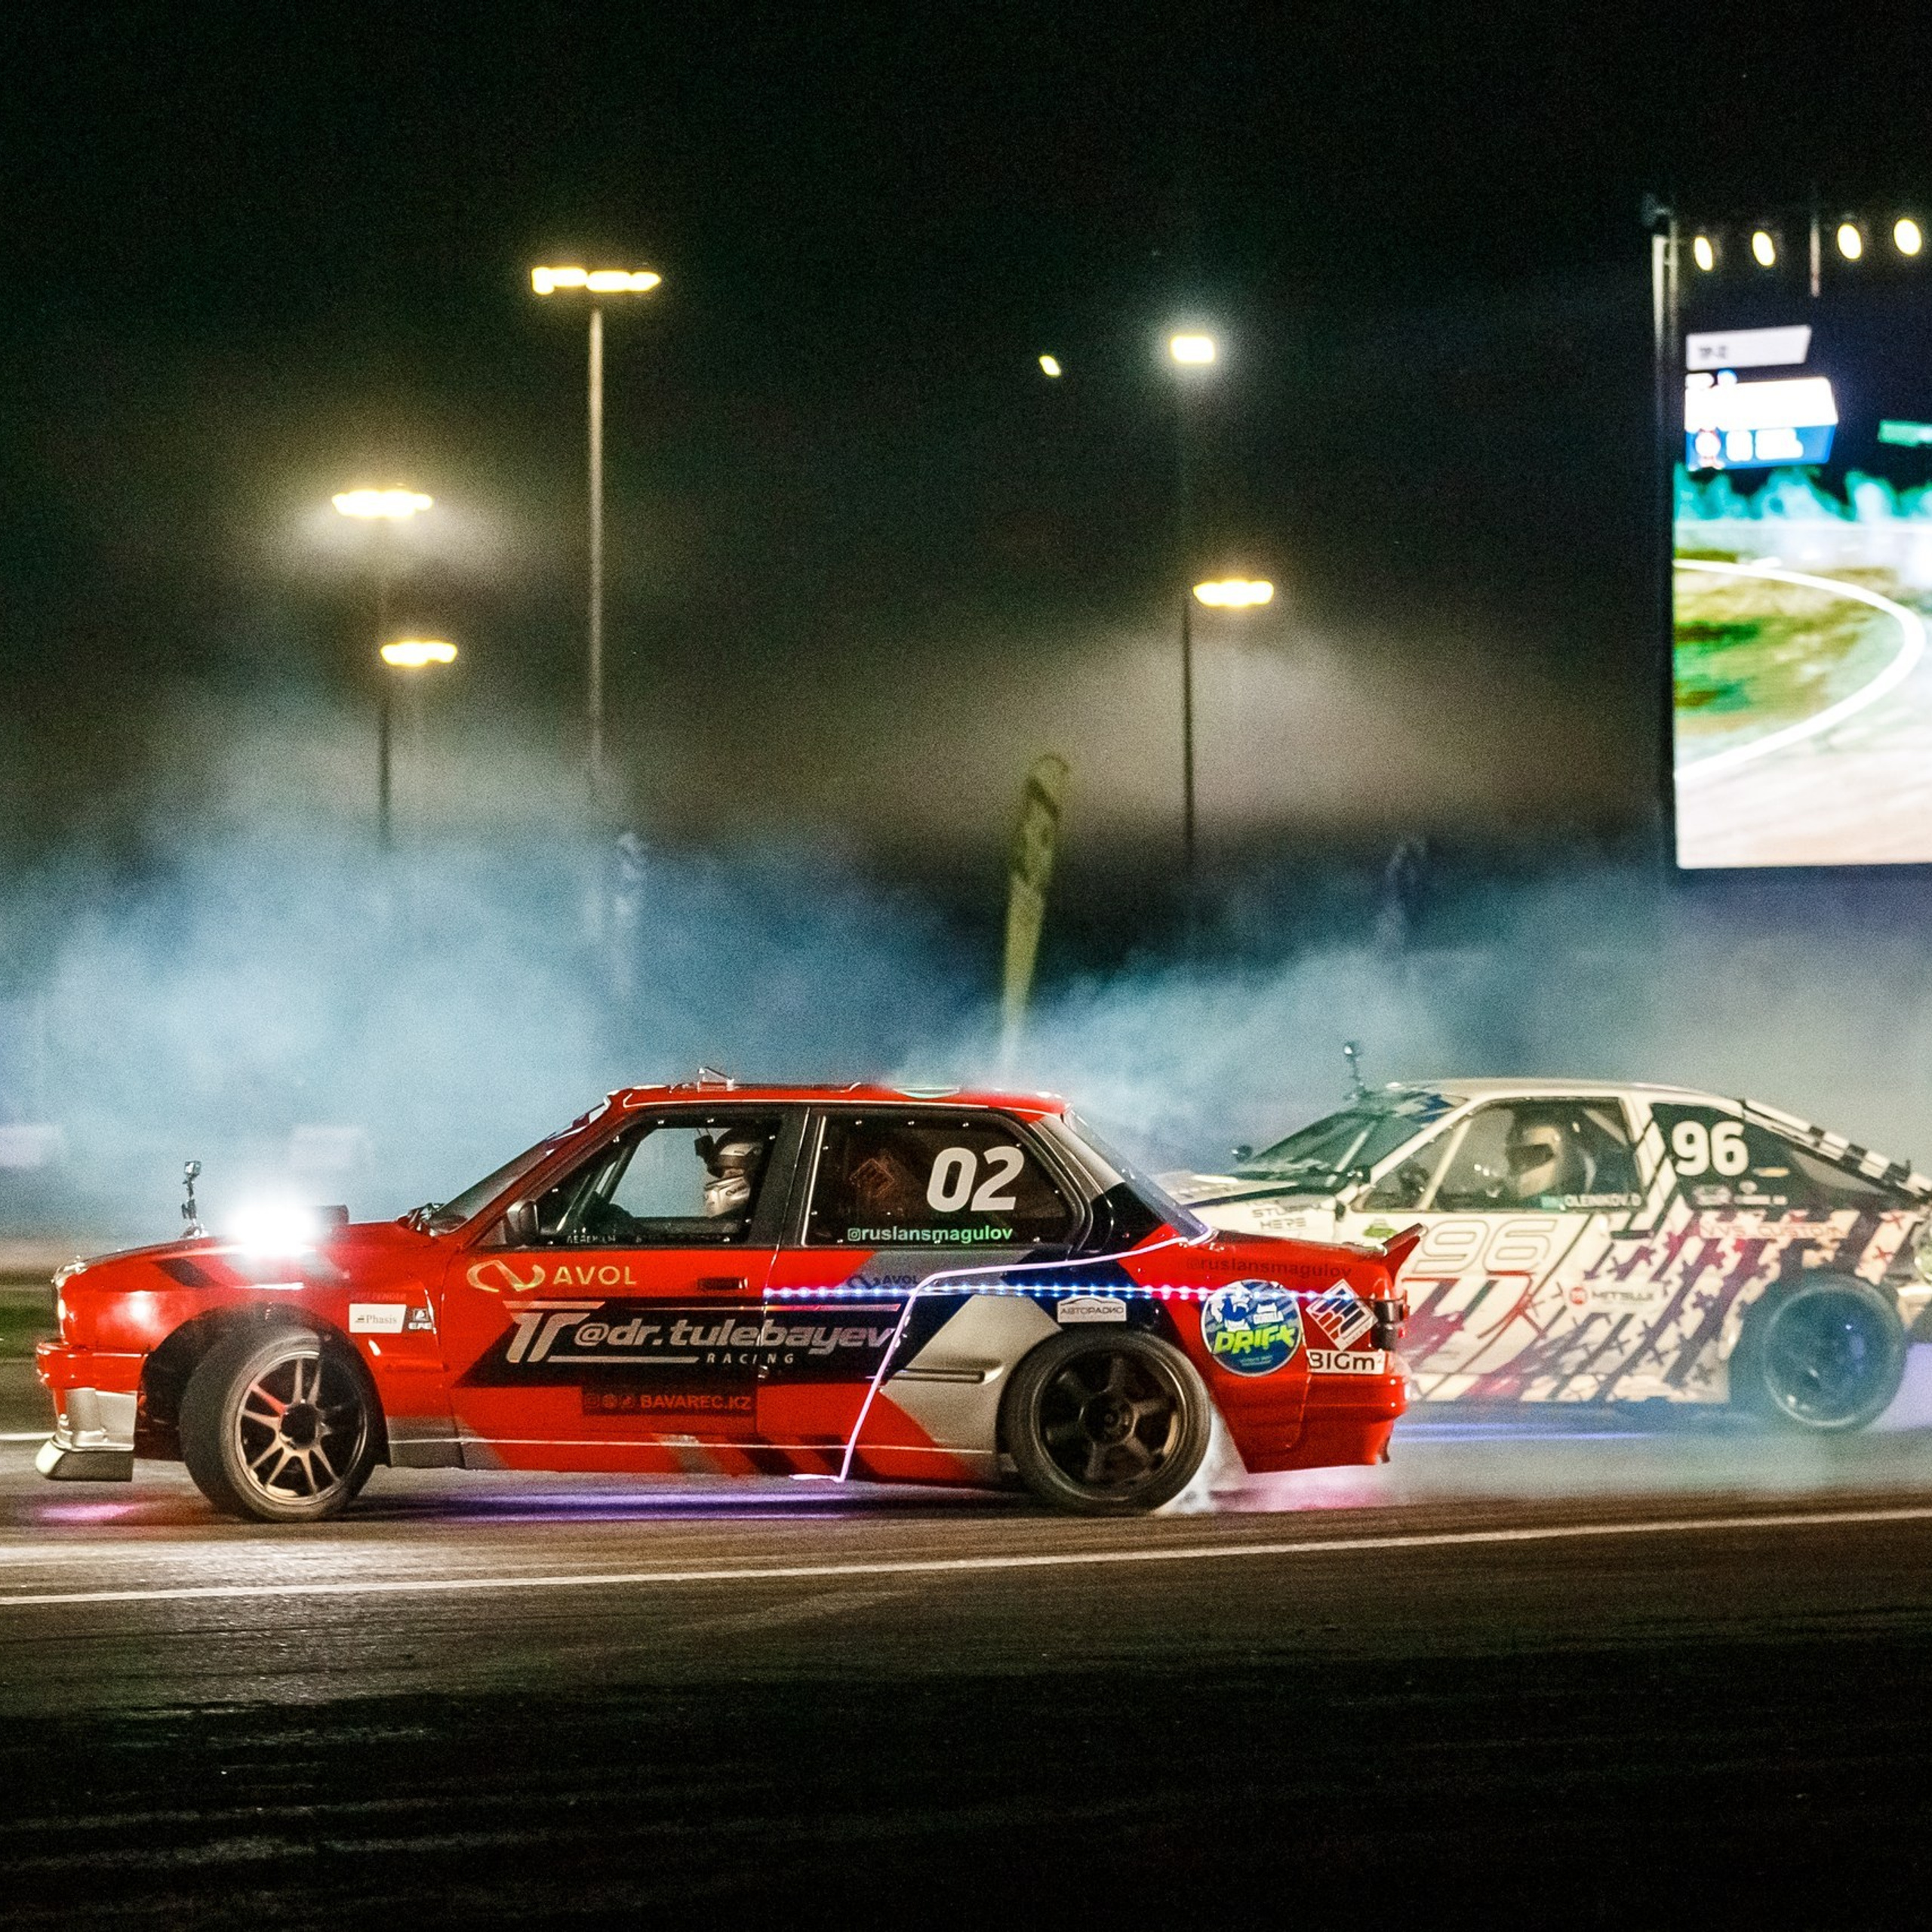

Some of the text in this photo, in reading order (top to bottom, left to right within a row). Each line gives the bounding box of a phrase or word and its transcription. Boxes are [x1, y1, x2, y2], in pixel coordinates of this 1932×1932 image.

[1672, 1121, 1749, 1177] 96
[927, 1146, 1024, 1212] 02
[1413, 1220, 1558, 1274] 96
[553, 1266, 637, 1284] AVOL
[366, 1315, 398, 1324] Phasis
[574, 1318, 896, 1355] @dr.tulebayev
[706, 1353, 794, 1364] RACING
[641, 1395, 752, 1411] BAVAREC.KZ
